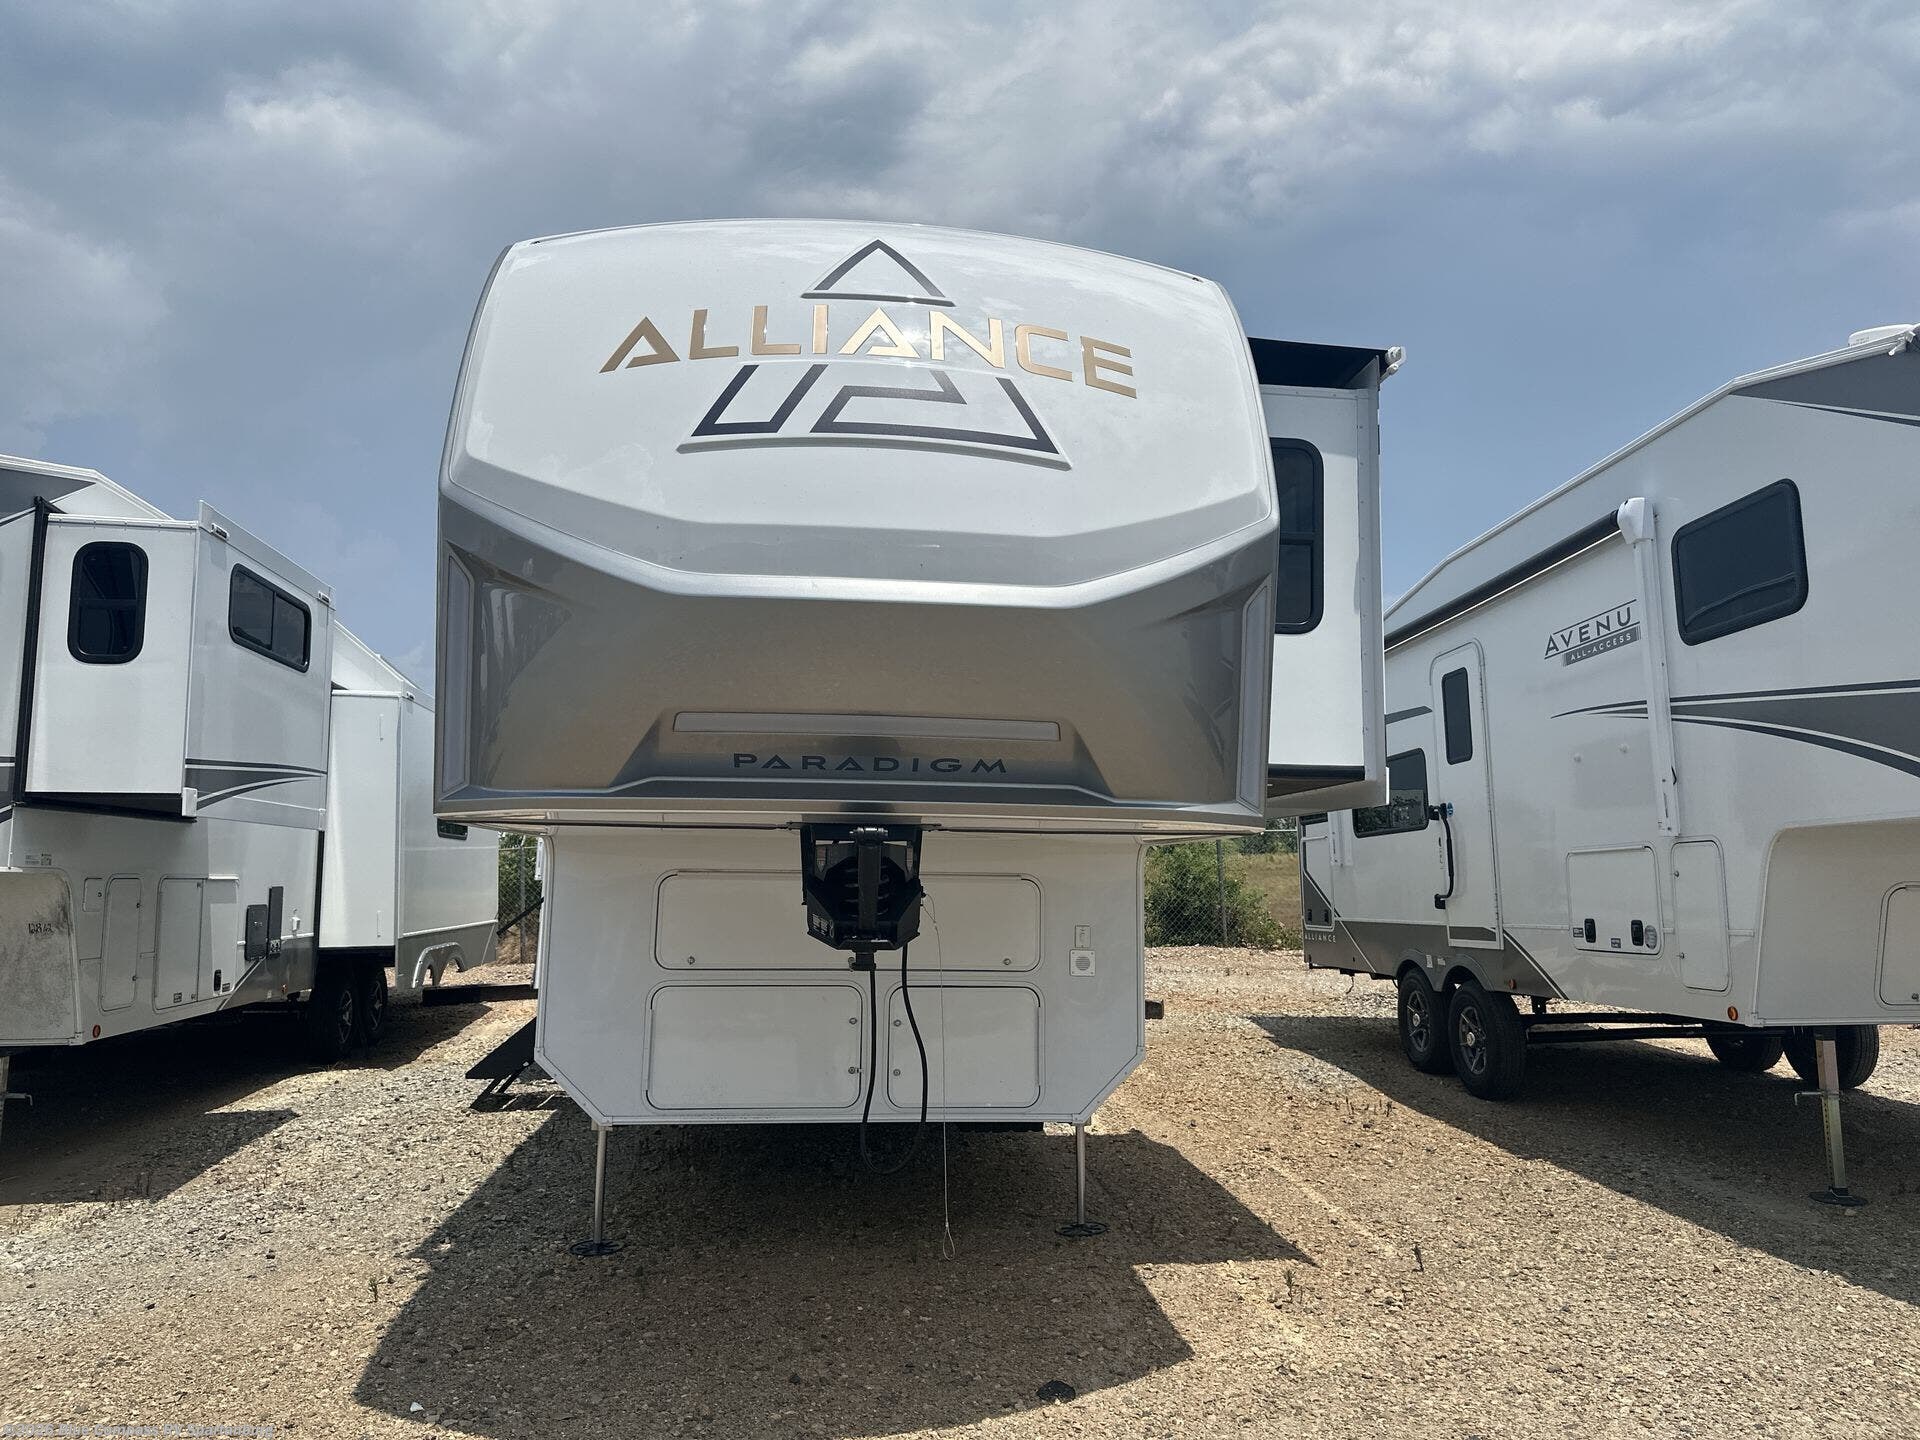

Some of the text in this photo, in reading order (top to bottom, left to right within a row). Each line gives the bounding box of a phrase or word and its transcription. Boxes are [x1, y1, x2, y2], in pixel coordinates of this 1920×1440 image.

[599, 304, 1137, 399] ALLIANCE
[1544, 606, 1632, 657] AVENU
[1570, 632, 1632, 661] ALL-ACCESS
[733, 752, 1008, 774] PARADIGM
